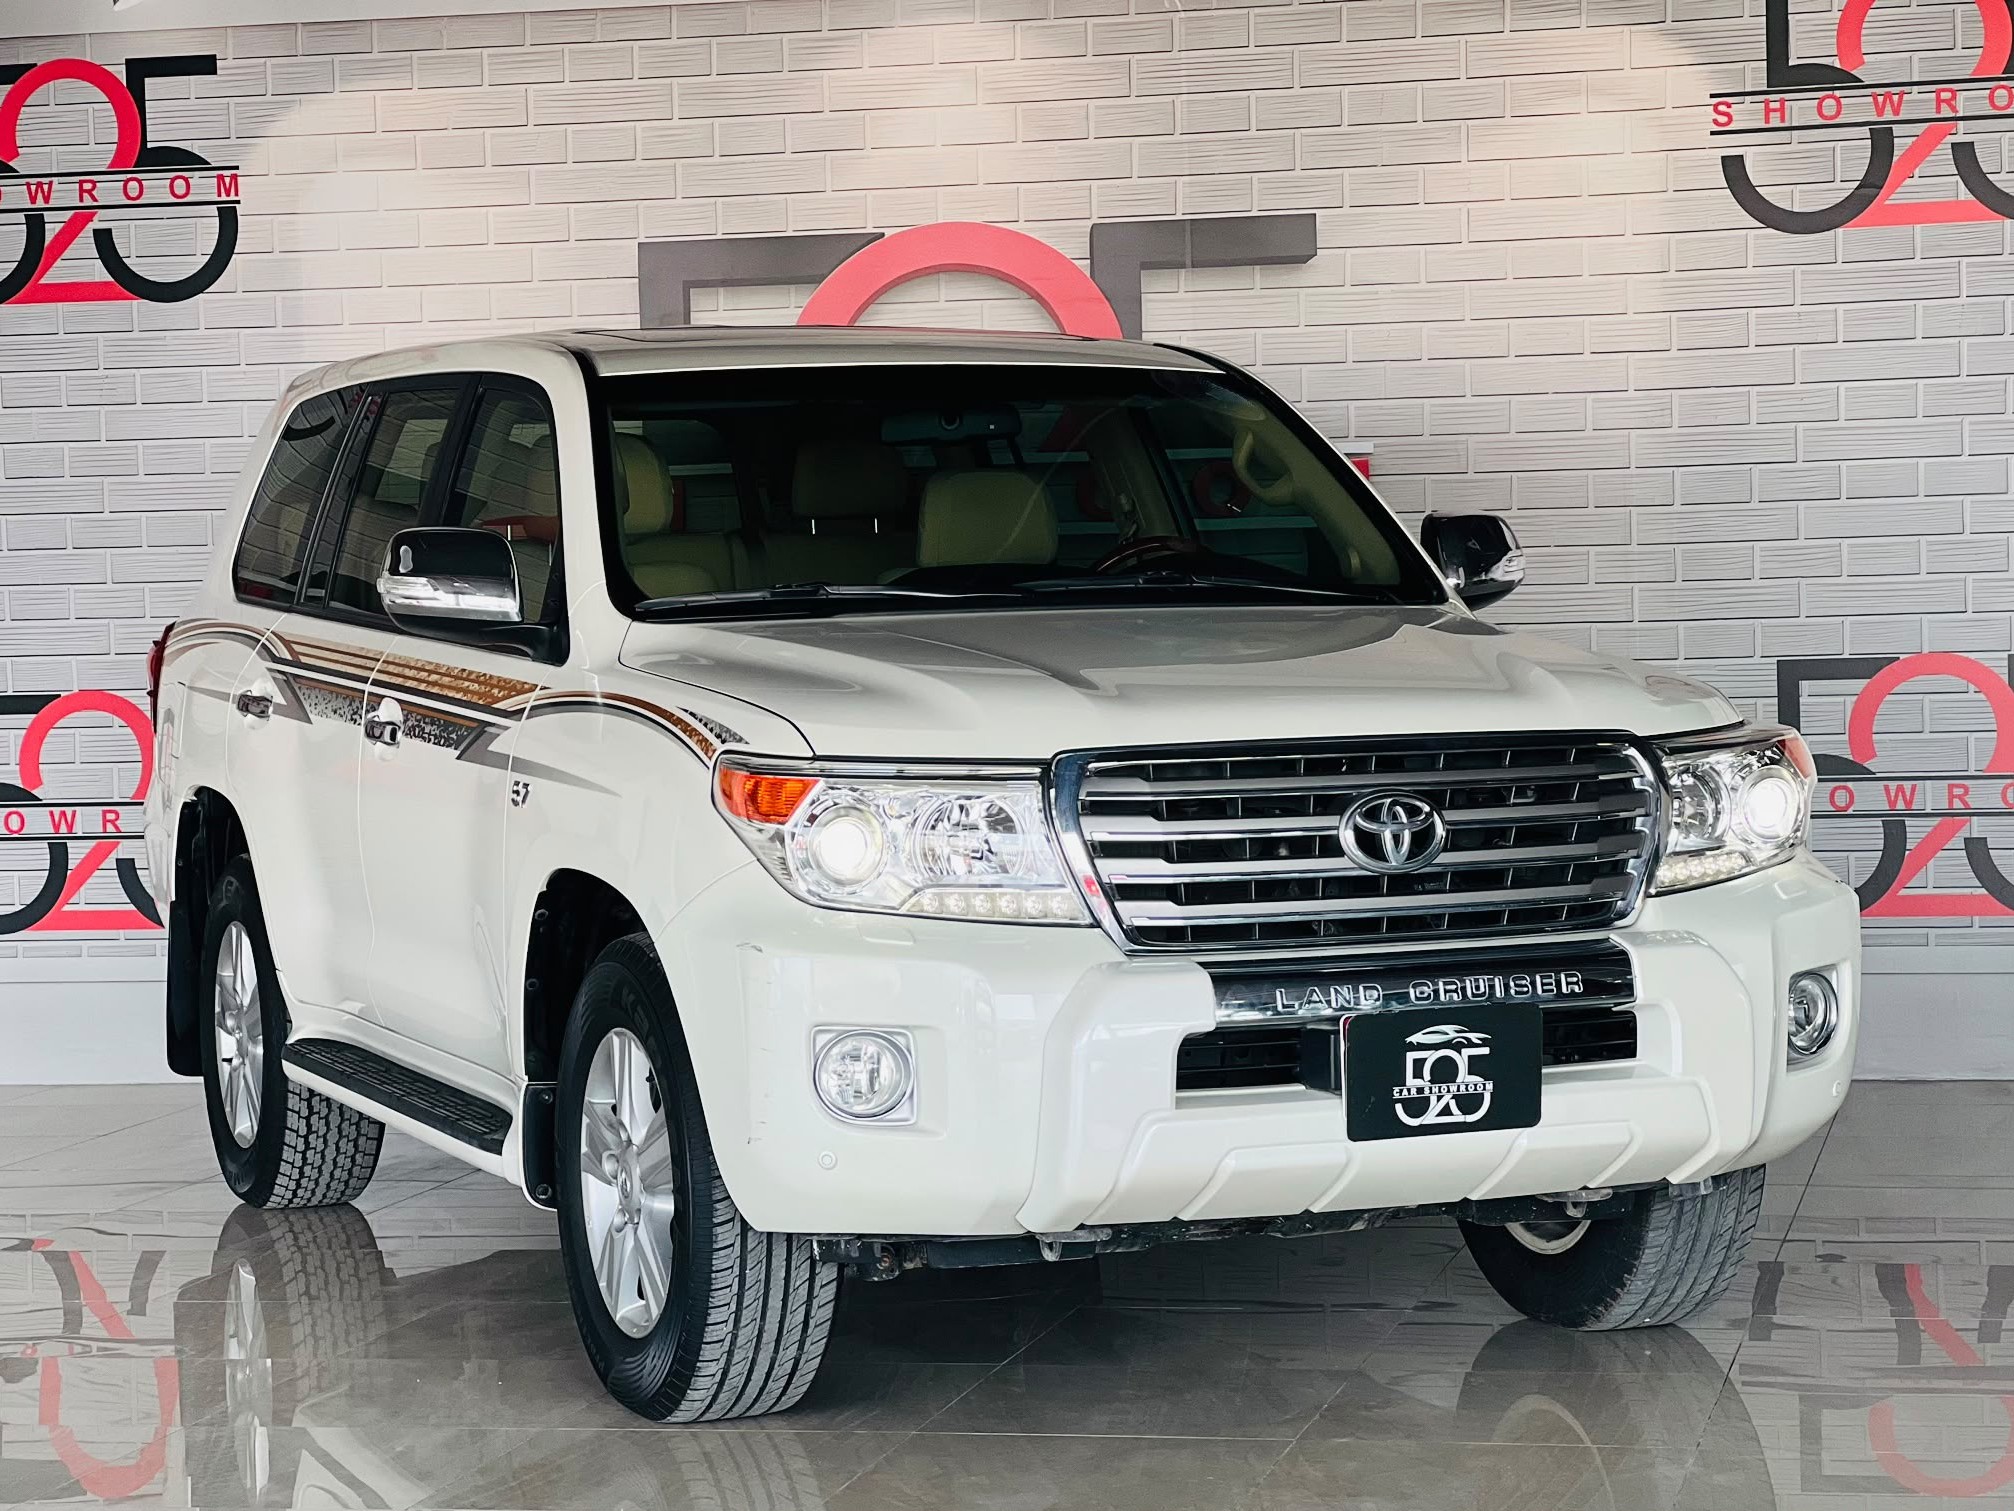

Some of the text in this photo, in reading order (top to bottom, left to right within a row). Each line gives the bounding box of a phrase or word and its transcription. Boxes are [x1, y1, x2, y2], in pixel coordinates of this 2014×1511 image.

[0, 173, 240, 205] WROOM
[1275, 971, 1584, 1012] LAND CRUISER
[1393, 1082, 1494, 1098] CAR SHOWROOM
